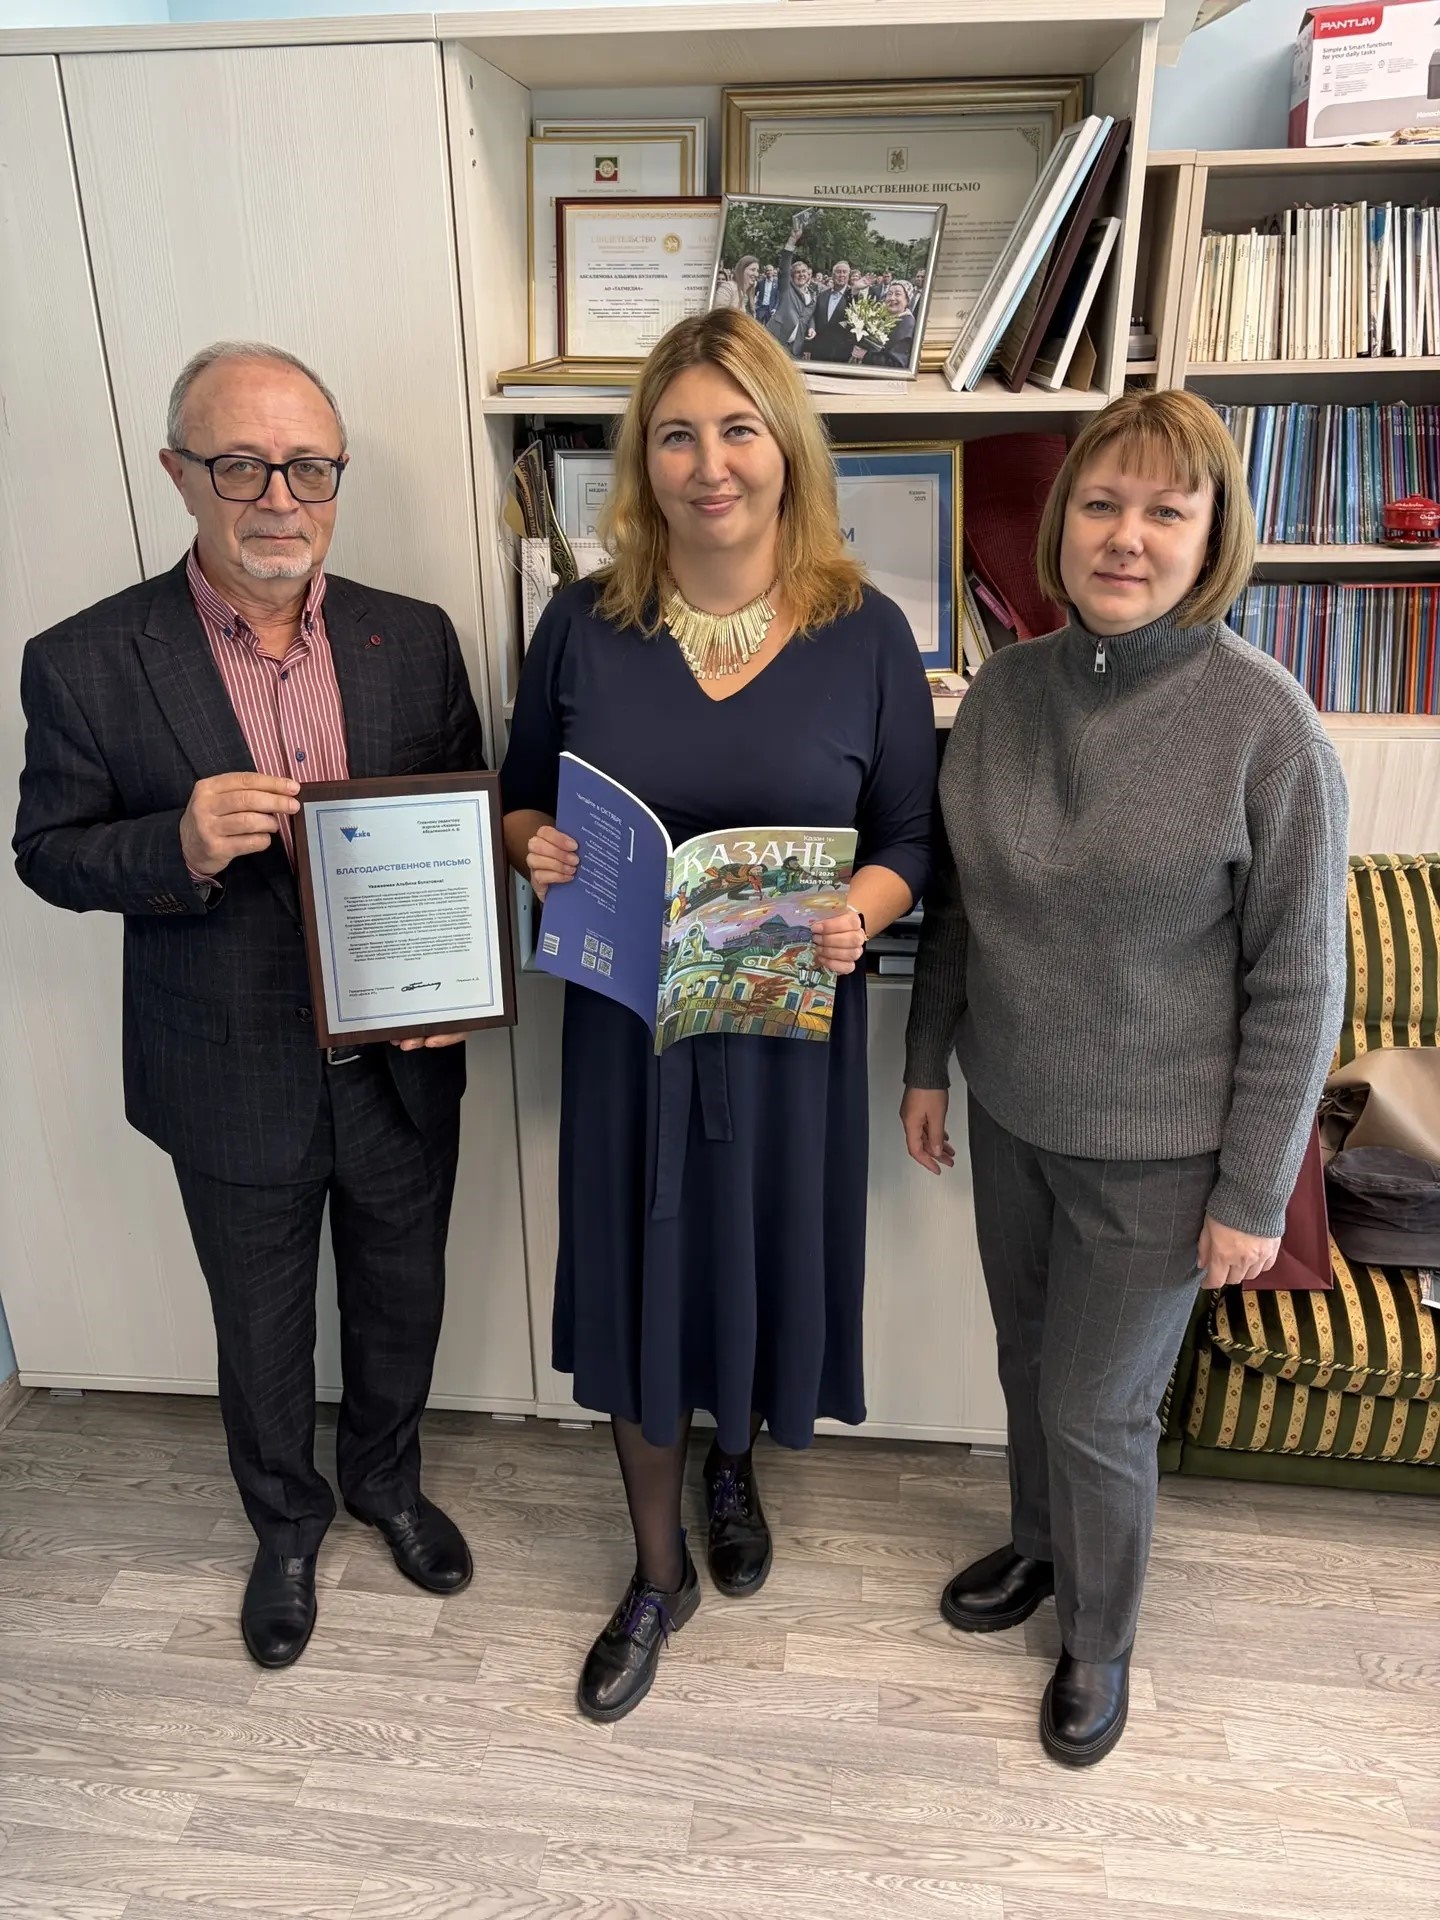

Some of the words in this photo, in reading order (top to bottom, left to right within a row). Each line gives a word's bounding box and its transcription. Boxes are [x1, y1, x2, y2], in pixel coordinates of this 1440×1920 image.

[1320, 17, 1376, 31] PANTUM
[1322, 46, 1342, 54] Simple
[1366, 41, 1393, 49] functions
[1345, 50, 1360, 58] daily
[813, 183, 930, 196] БЛАГОДАРСТВЕННОЕ
[931, 181, 981, 193] ПИСЬМО
[336, 862, 432, 875] БЛАГОДАРСТВЕННОЕ
[433, 858, 472, 868] ПИСЬМО
[682, 841, 837, 880] КАЗАНЬ
